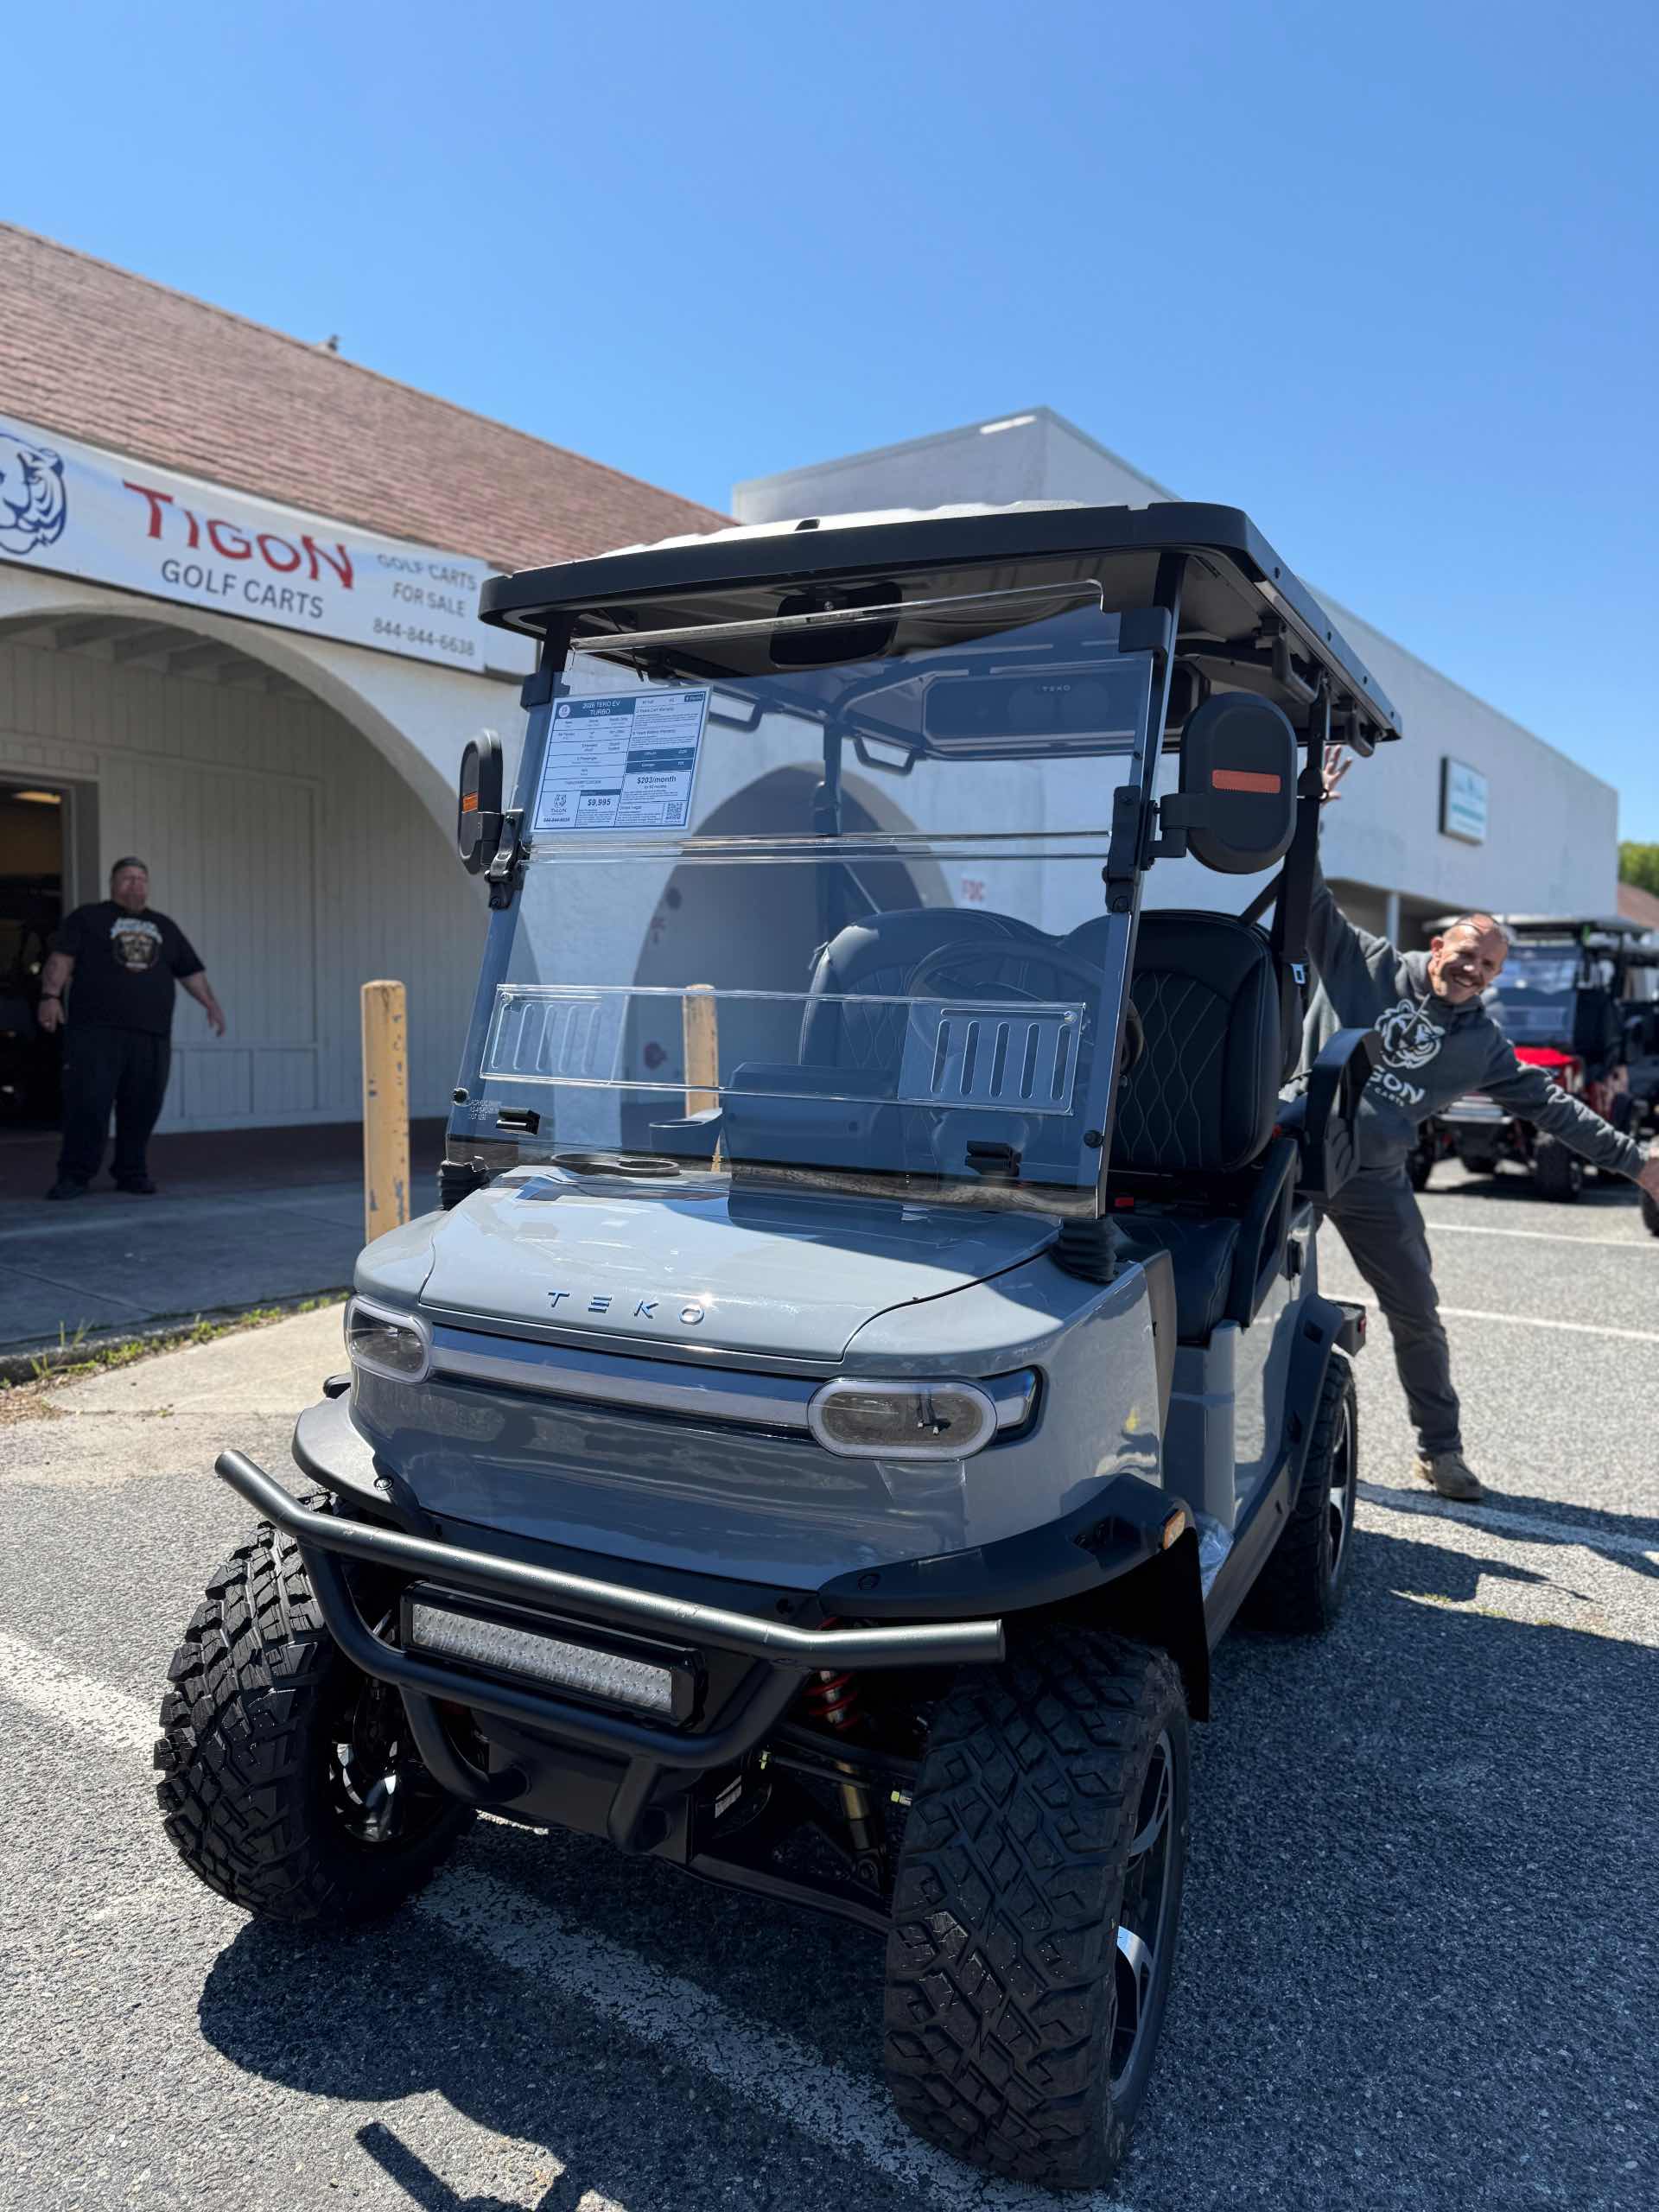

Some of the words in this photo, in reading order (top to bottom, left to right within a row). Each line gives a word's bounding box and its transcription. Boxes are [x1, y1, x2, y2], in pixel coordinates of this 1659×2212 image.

[123, 480, 354, 590] TIGON
[162, 558, 237, 596] GOLF
[244, 579, 324, 619] CARTS
[428, 564, 477, 591] CARTS
[392, 582, 424, 604] FOR
[427, 592, 465, 618] SALE
[373, 617, 475, 657] 844-844-6638
[588, 798, 611, 807] $9,995
[1369, 1065, 1425, 1105] GON
[547, 1292, 705, 1325] TEKO
